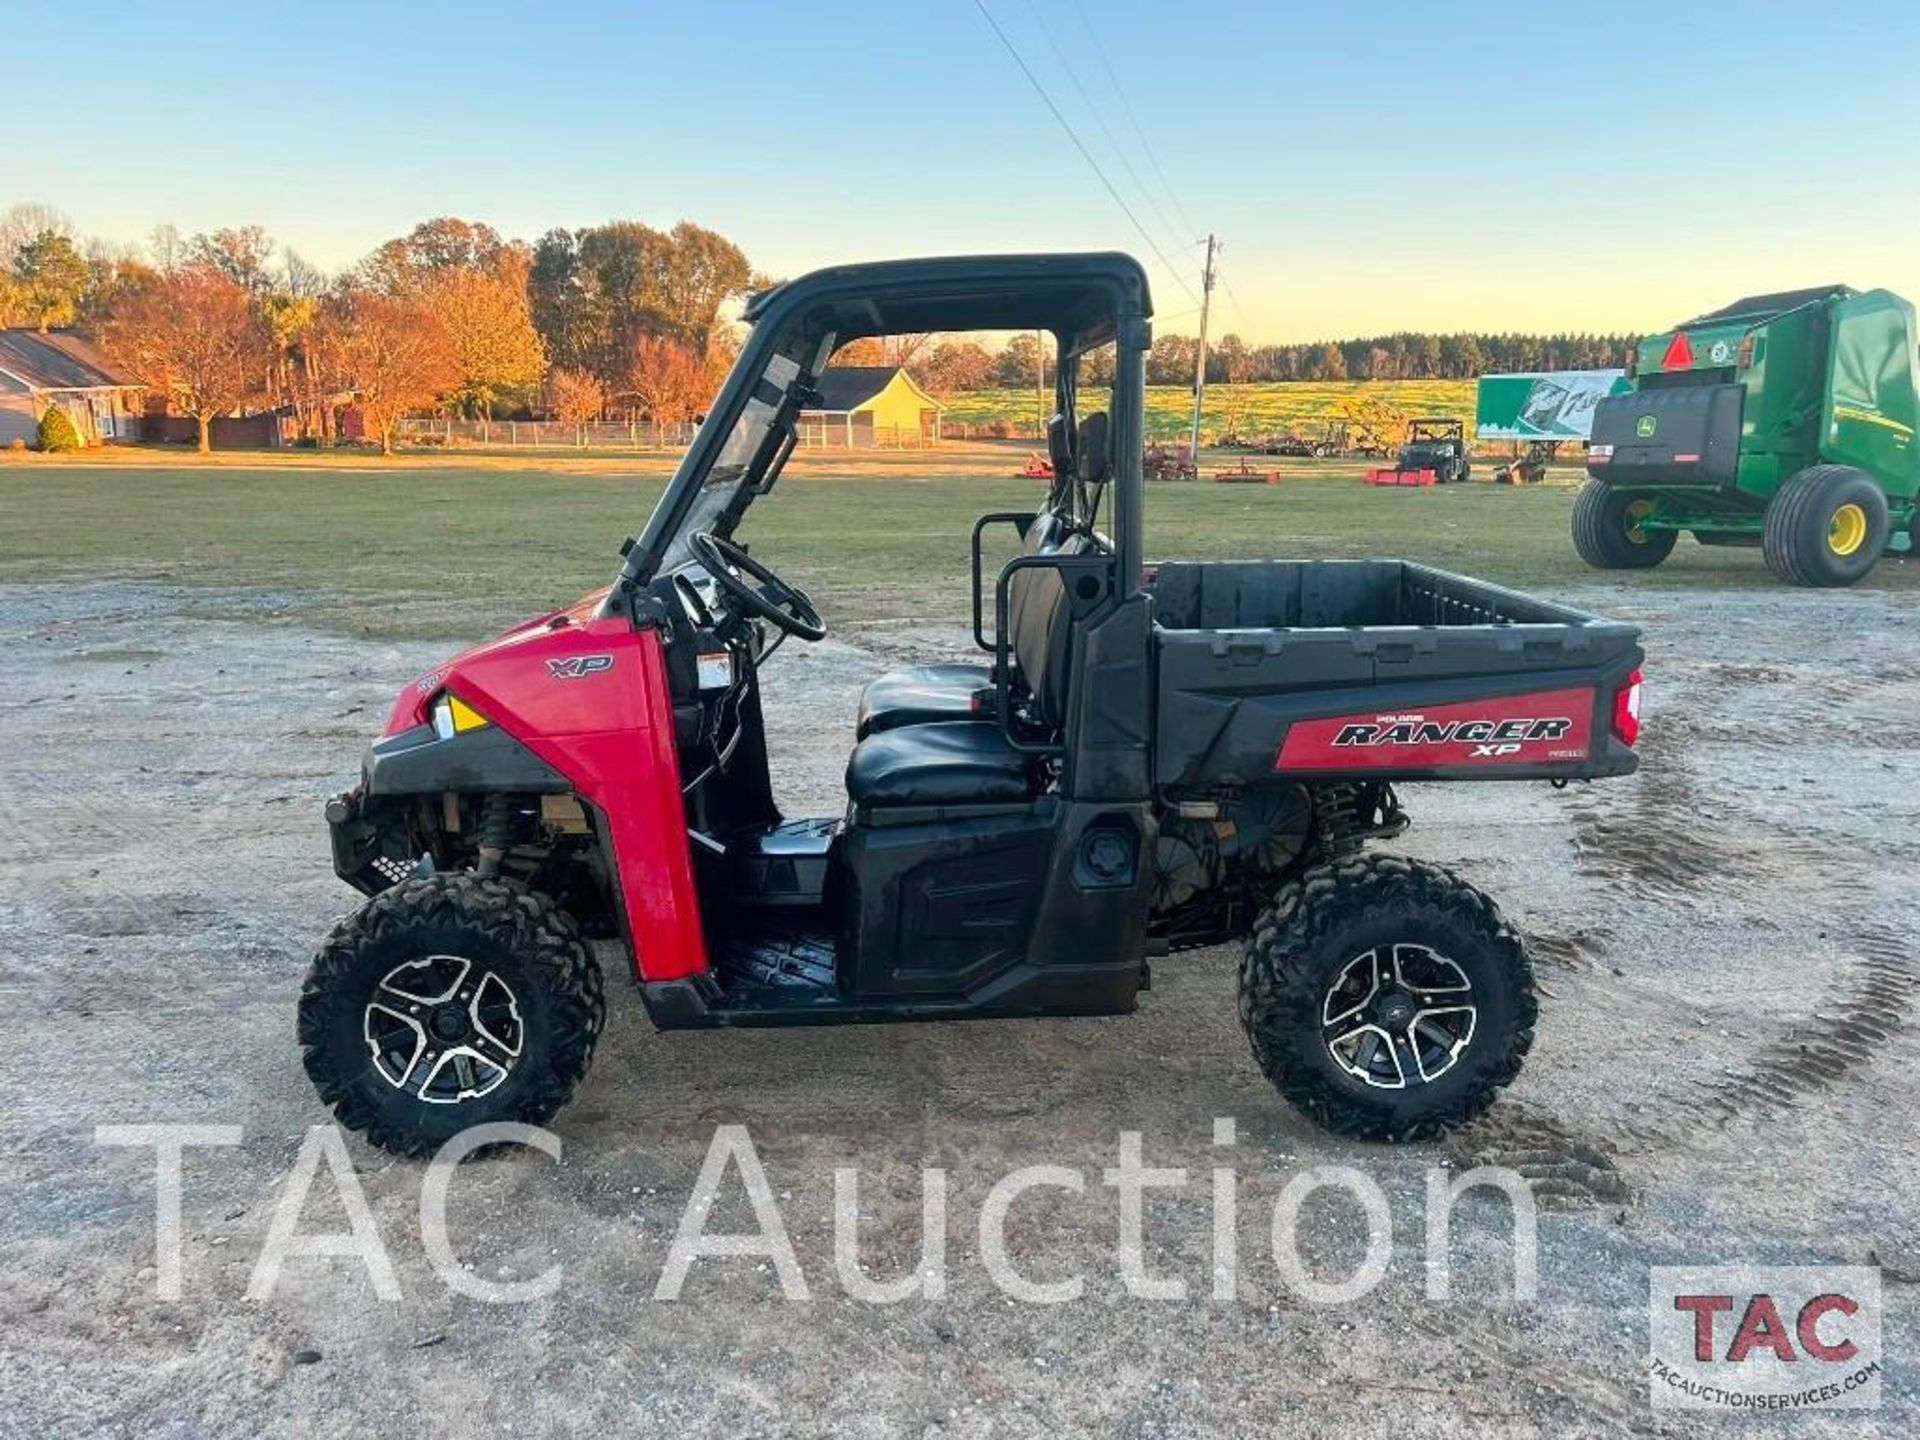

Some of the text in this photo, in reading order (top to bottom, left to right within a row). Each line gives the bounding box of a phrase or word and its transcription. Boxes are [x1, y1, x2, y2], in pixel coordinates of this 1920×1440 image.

[544, 654, 614, 678] XP
[1331, 717, 1573, 747] RANGER
[1468, 743, 1522, 758] XP
